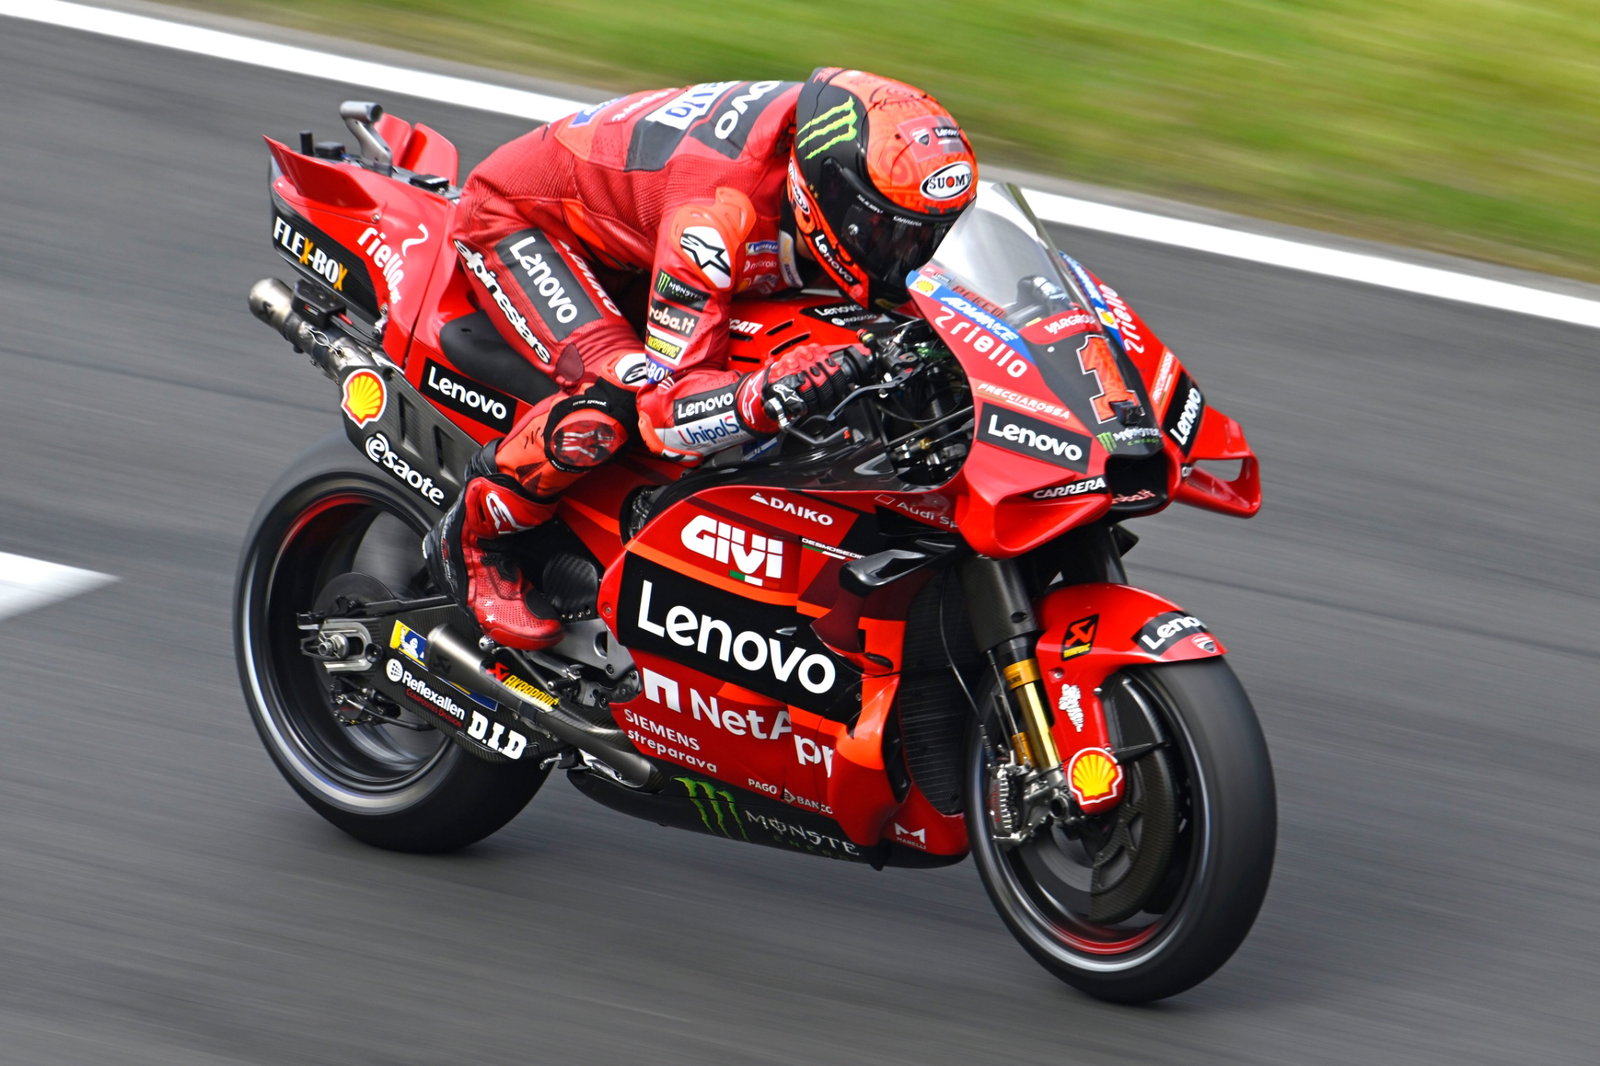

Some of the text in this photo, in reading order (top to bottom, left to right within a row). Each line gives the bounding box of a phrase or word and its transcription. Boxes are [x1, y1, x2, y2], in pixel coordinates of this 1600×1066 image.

[273, 216, 348, 292] FLEX-BOX
[357, 226, 405, 291] riello
[814, 233, 854, 282] Lenovo
[454, 240, 551, 364] alpinestars
[509, 236, 578, 324] Lenovo
[940, 296, 1019, 342] ADVANCE
[950, 322, 1028, 378] riello
[428, 366, 507, 420] Lenovo
[977, 383, 1070, 419] FRECCIAROSSA
[1076, 334, 1146, 424] 1
[678, 392, 734, 419] Lenovo
[1169, 388, 1202, 446] Lenovo
[988, 414, 1082, 461] Lenovo
[365, 432, 445, 506] esaote
[1033, 477, 1106, 499] CARRERA
[770, 497, 833, 526] DAIKO
[897, 502, 935, 520] Audi
[681, 515, 783, 579] GIVI
[637, 580, 836, 694] Lenovo
[402, 670, 465, 720] Reflexallen
[467, 710, 528, 760] D.I.D
[624, 709, 701, 751] SIEMENS
[627, 729, 718, 773] streparava
[748, 778, 778, 795] PAGO
